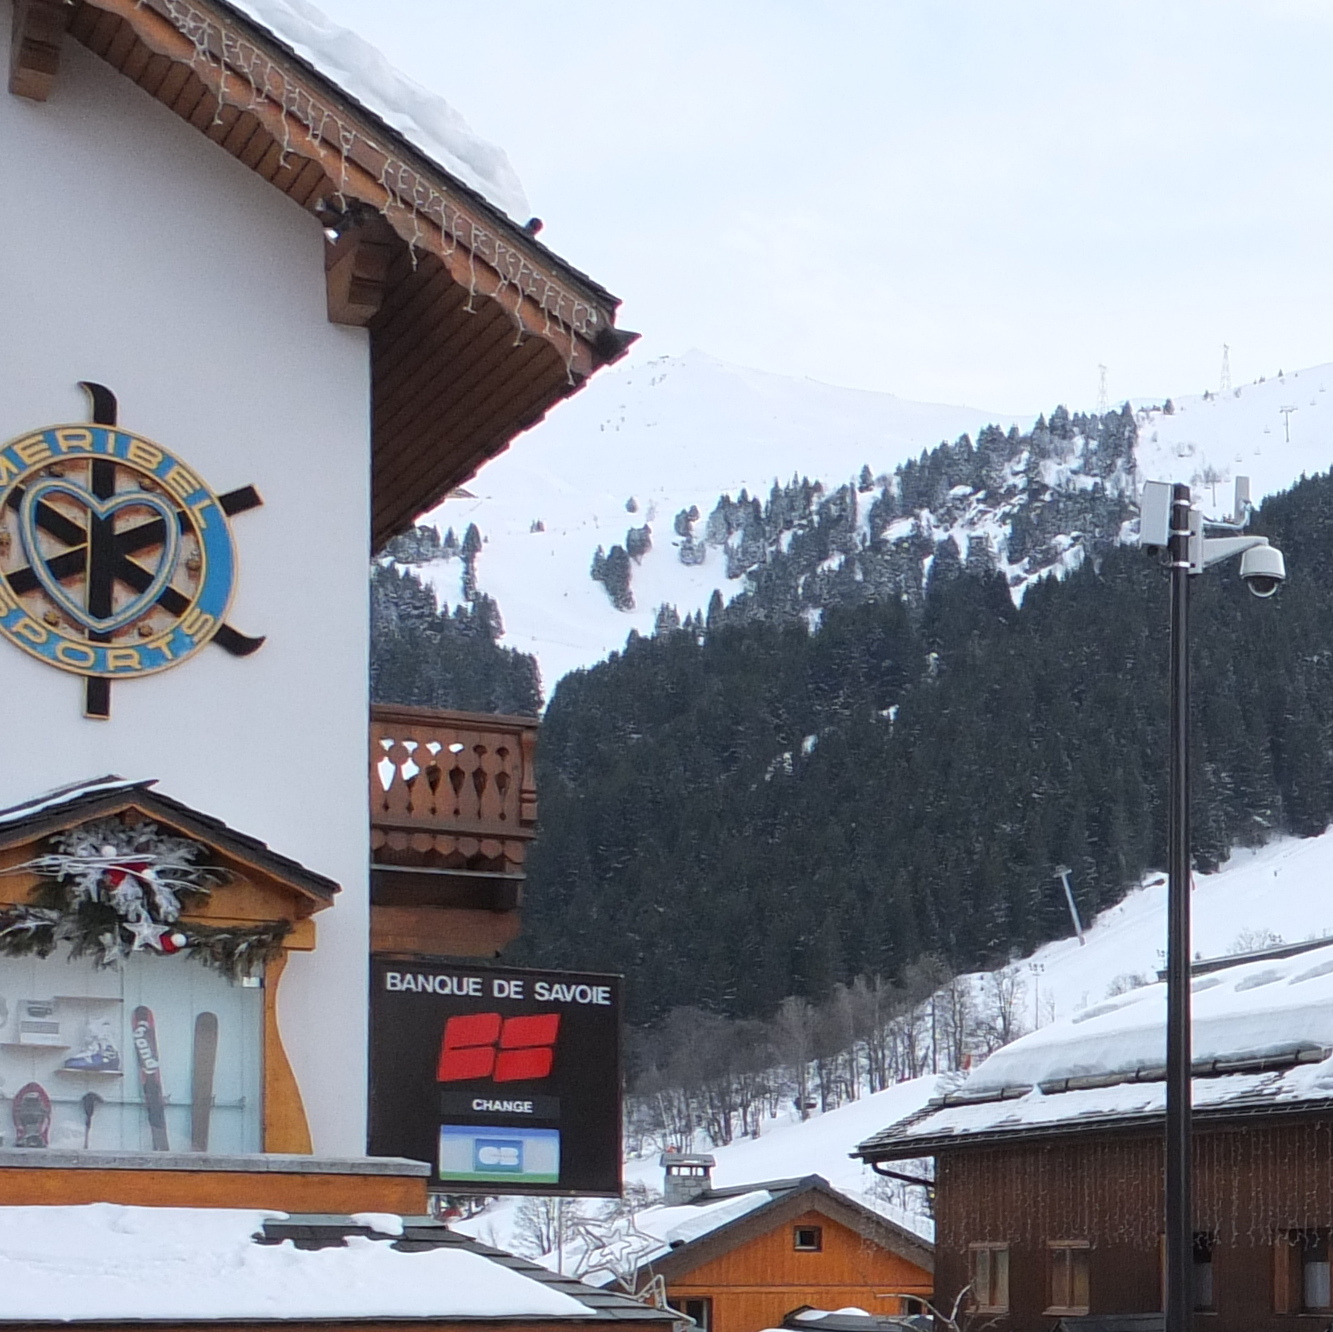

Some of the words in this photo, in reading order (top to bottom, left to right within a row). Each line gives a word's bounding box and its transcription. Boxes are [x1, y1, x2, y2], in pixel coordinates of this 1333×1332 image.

[386, 972, 483, 996] BANQUE
[493, 979, 524, 999] DE
[534, 982, 612, 1005] SAVOIE
[472, 1099, 534, 1113] CHANGE
